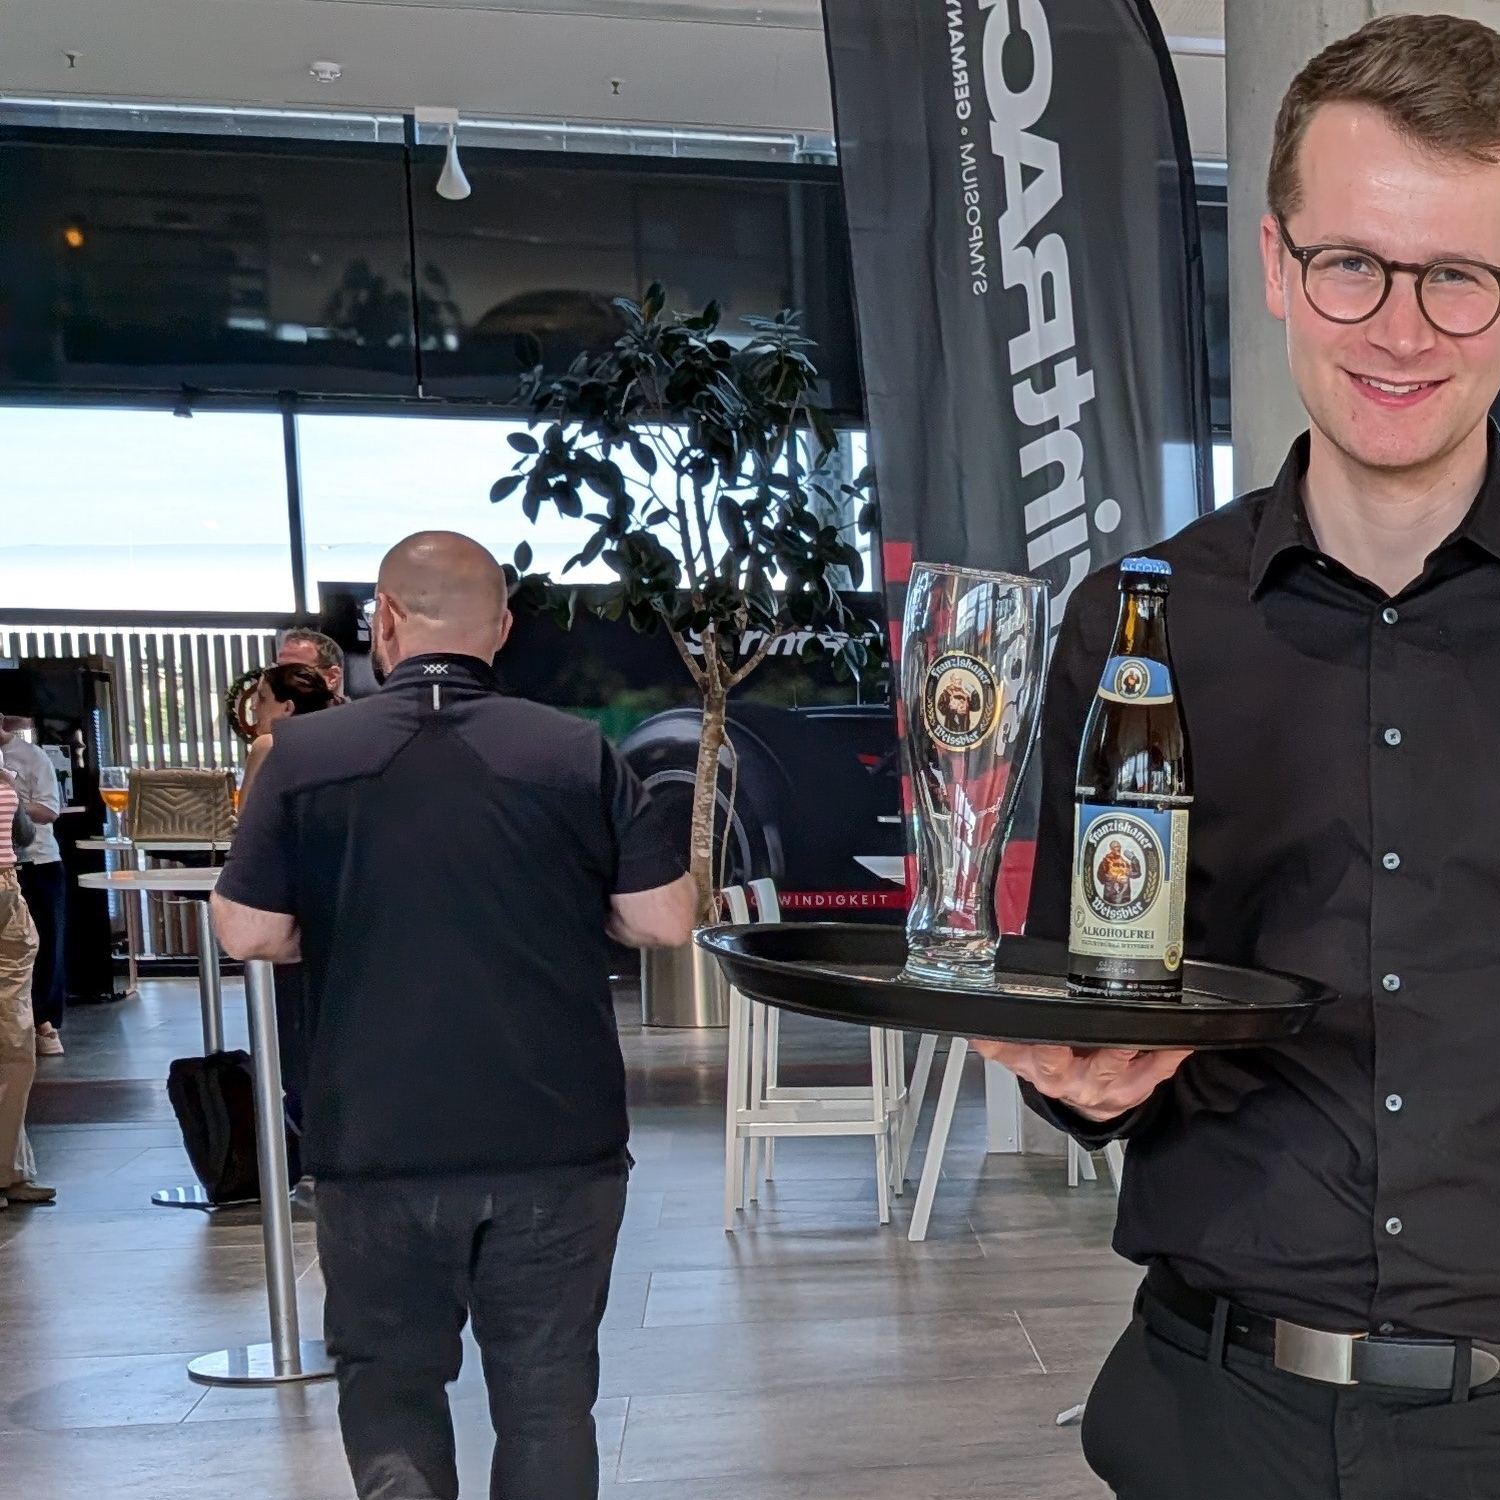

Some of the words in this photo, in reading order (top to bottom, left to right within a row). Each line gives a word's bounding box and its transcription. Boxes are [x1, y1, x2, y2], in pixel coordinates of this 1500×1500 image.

[931, 656, 991, 685] Franziskaner
[1088, 820, 1153, 850] Franziskaner
[1082, 925, 1155, 939] ALKOHOLFREI
